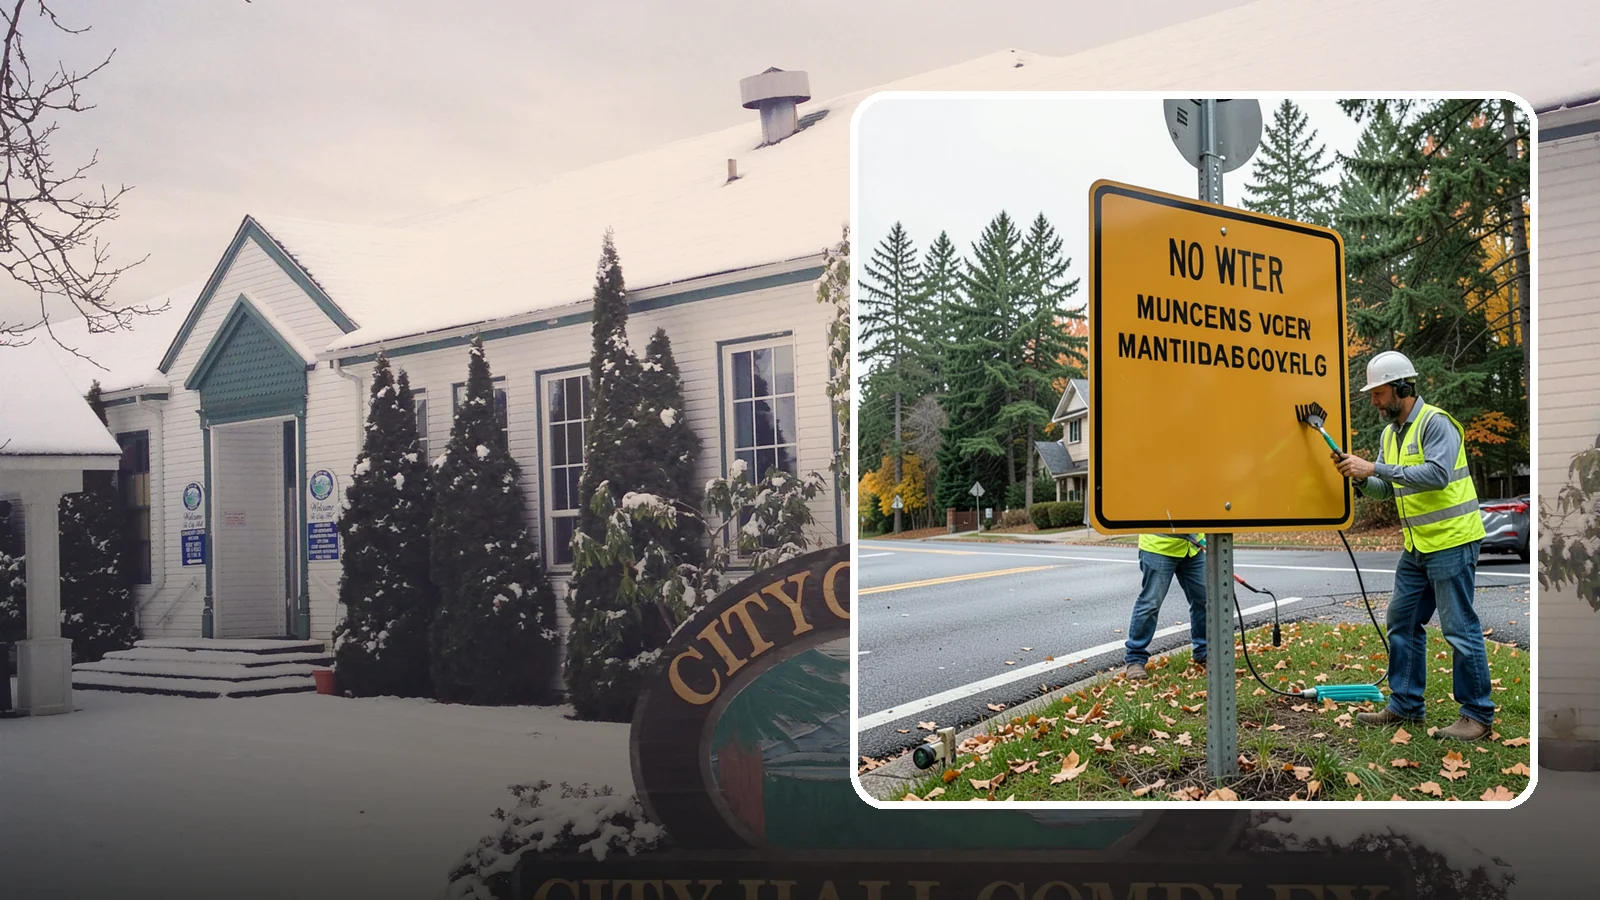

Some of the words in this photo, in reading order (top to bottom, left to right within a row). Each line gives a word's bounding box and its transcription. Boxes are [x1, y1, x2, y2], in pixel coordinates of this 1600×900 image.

[1170, 237, 1204, 281] NO
[1215, 245, 1284, 294] WTER
[1137, 294, 1252, 333] MUNCENS
[668, 571, 813, 705] CITY
